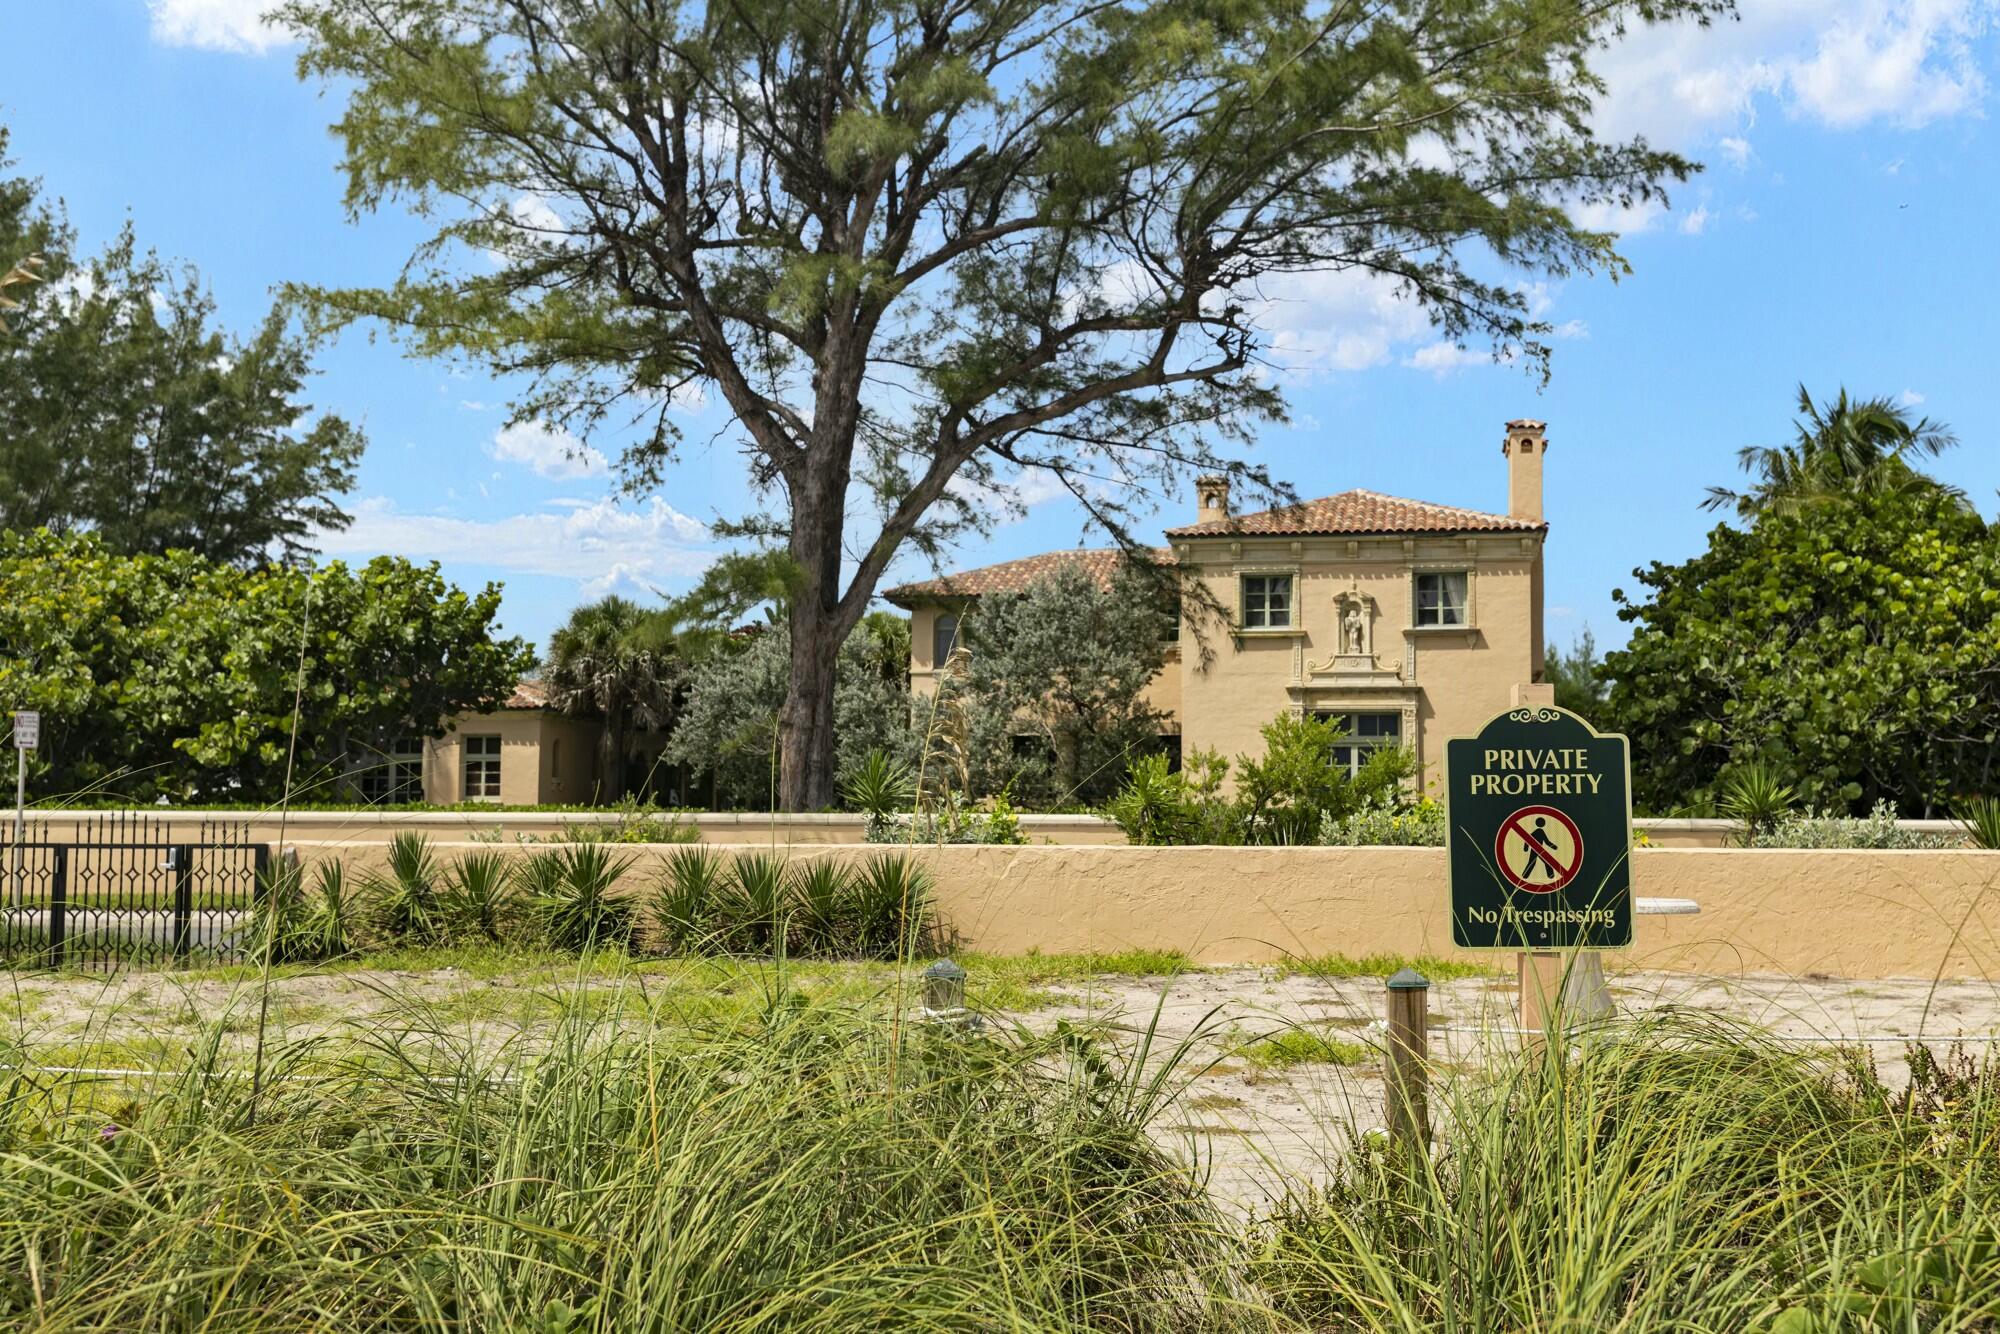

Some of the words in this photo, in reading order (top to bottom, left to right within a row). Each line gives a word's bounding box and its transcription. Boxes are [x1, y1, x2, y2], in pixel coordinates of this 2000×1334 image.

[1485, 749, 1588, 770] PRIVATE
[1471, 773, 1603, 795] PROPERTY
[1468, 906, 1498, 924] No
[1503, 903, 1616, 929] Trespassing
